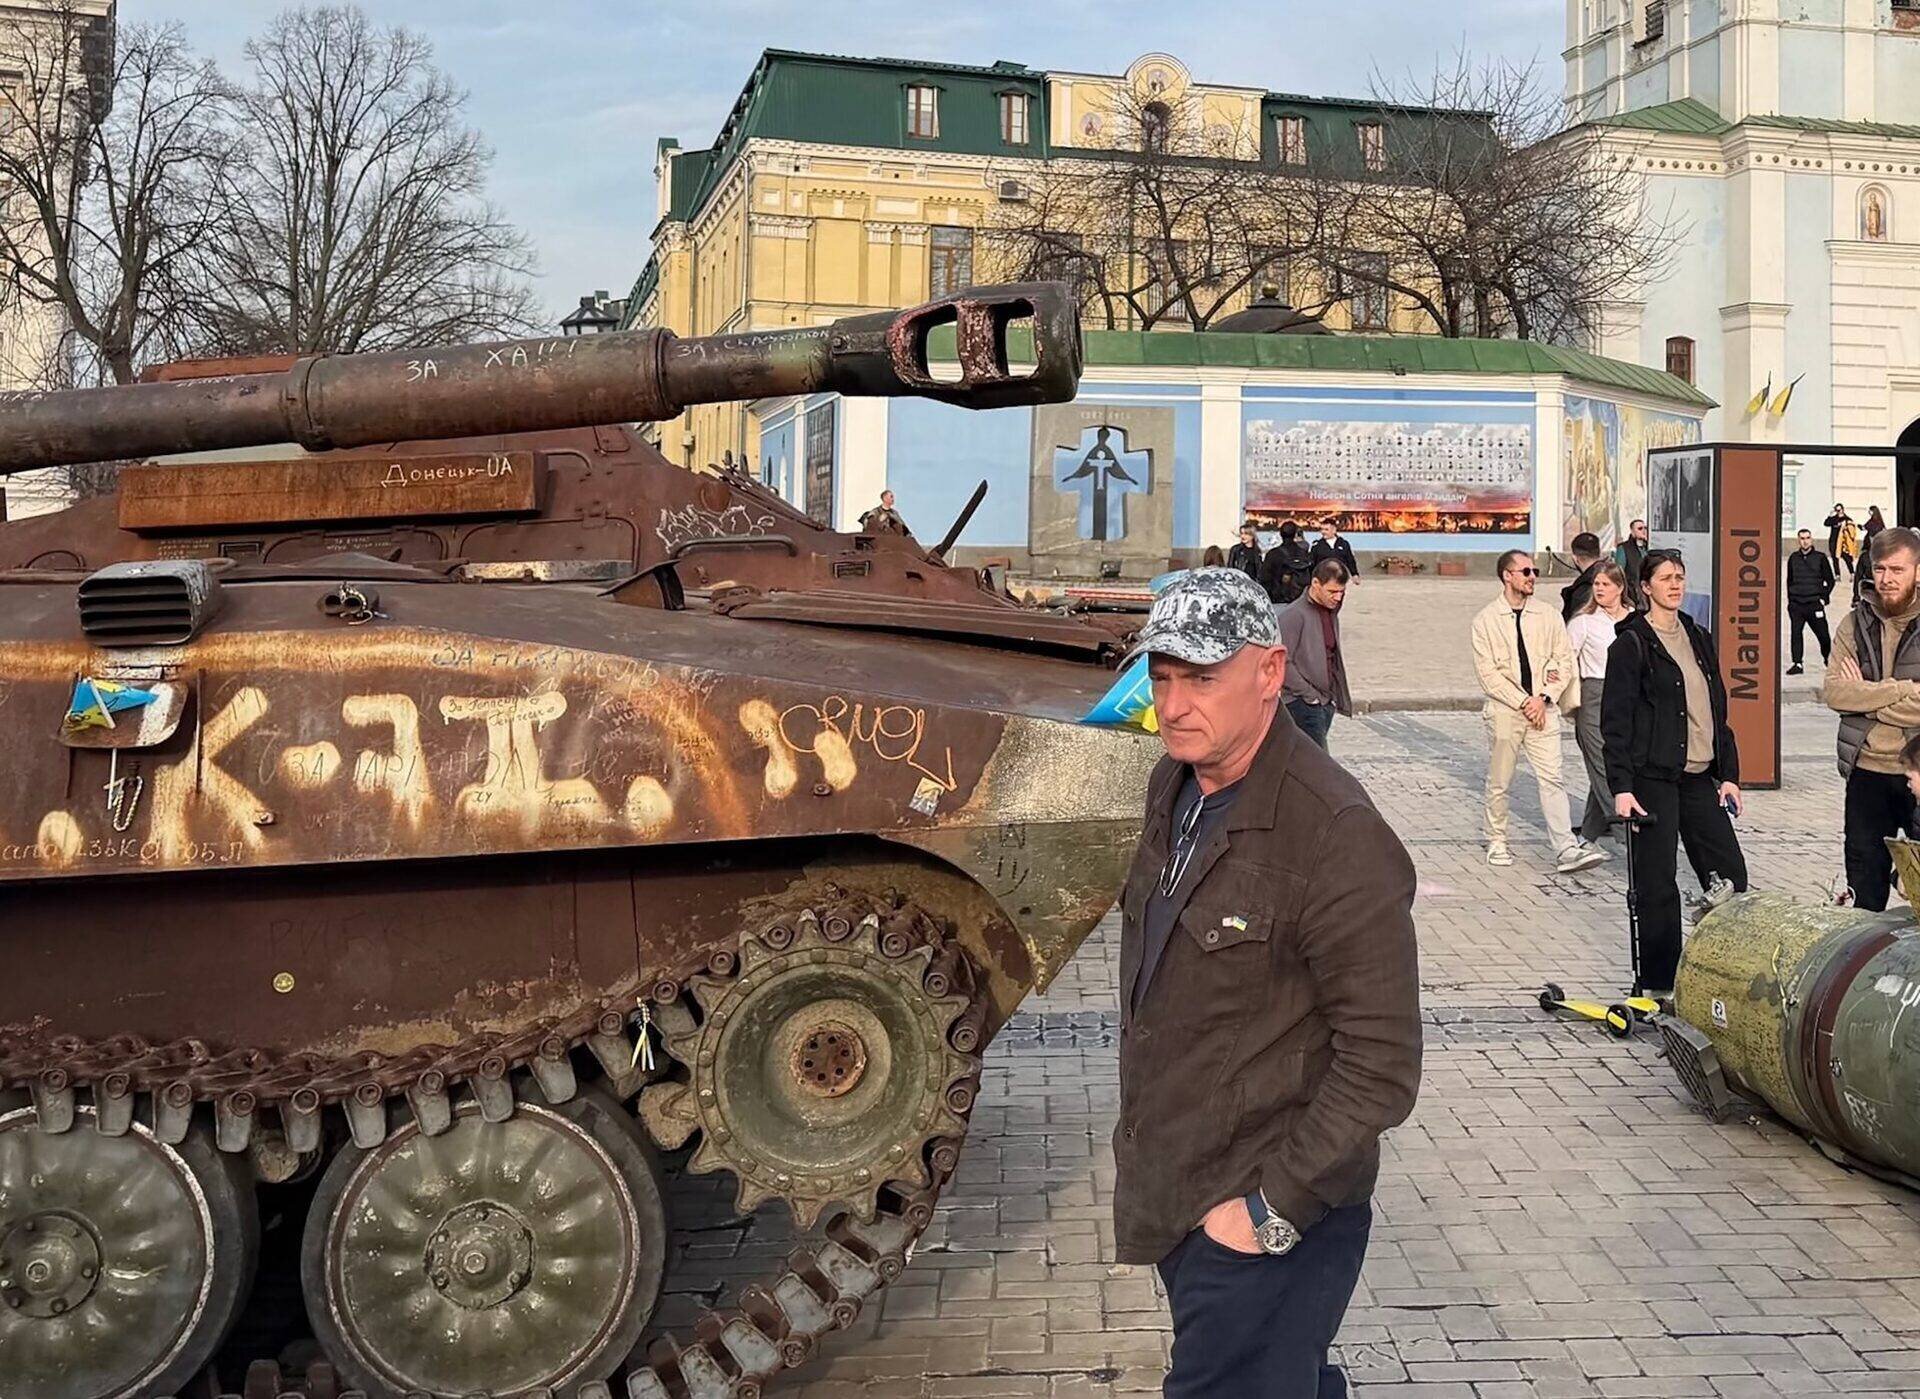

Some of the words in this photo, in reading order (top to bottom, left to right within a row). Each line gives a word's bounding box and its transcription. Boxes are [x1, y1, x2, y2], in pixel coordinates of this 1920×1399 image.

[406, 359, 438, 382] ЗА
[1354, 490, 1384, 500] Сотня
[1730, 528, 1766, 700] Mariupol
